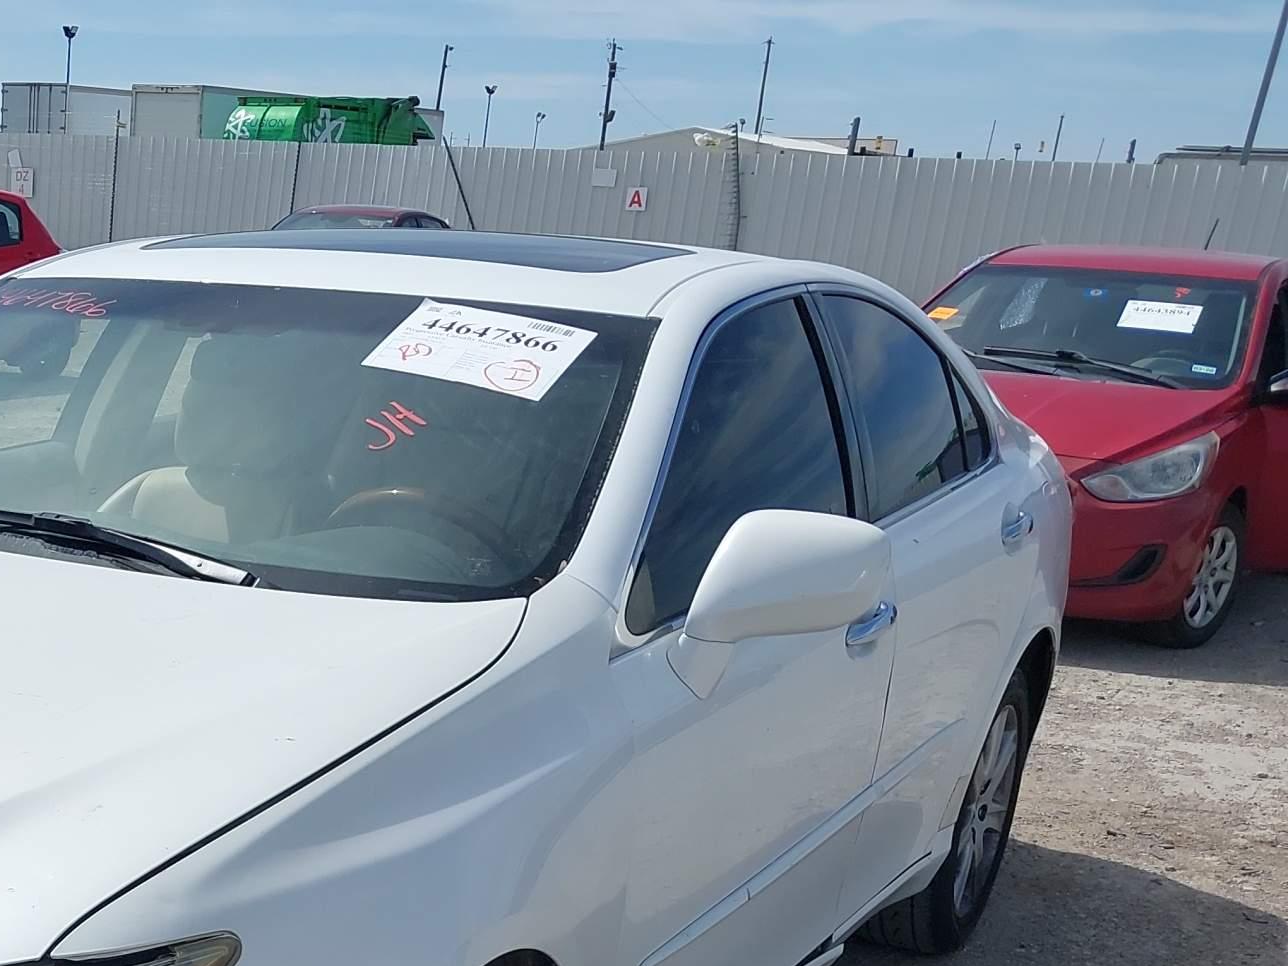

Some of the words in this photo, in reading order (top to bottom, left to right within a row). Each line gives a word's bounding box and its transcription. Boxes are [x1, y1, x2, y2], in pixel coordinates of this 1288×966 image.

[15, 170, 29, 182] DZ
[628, 189, 643, 208] A
[421, 317, 560, 352] 44647866
